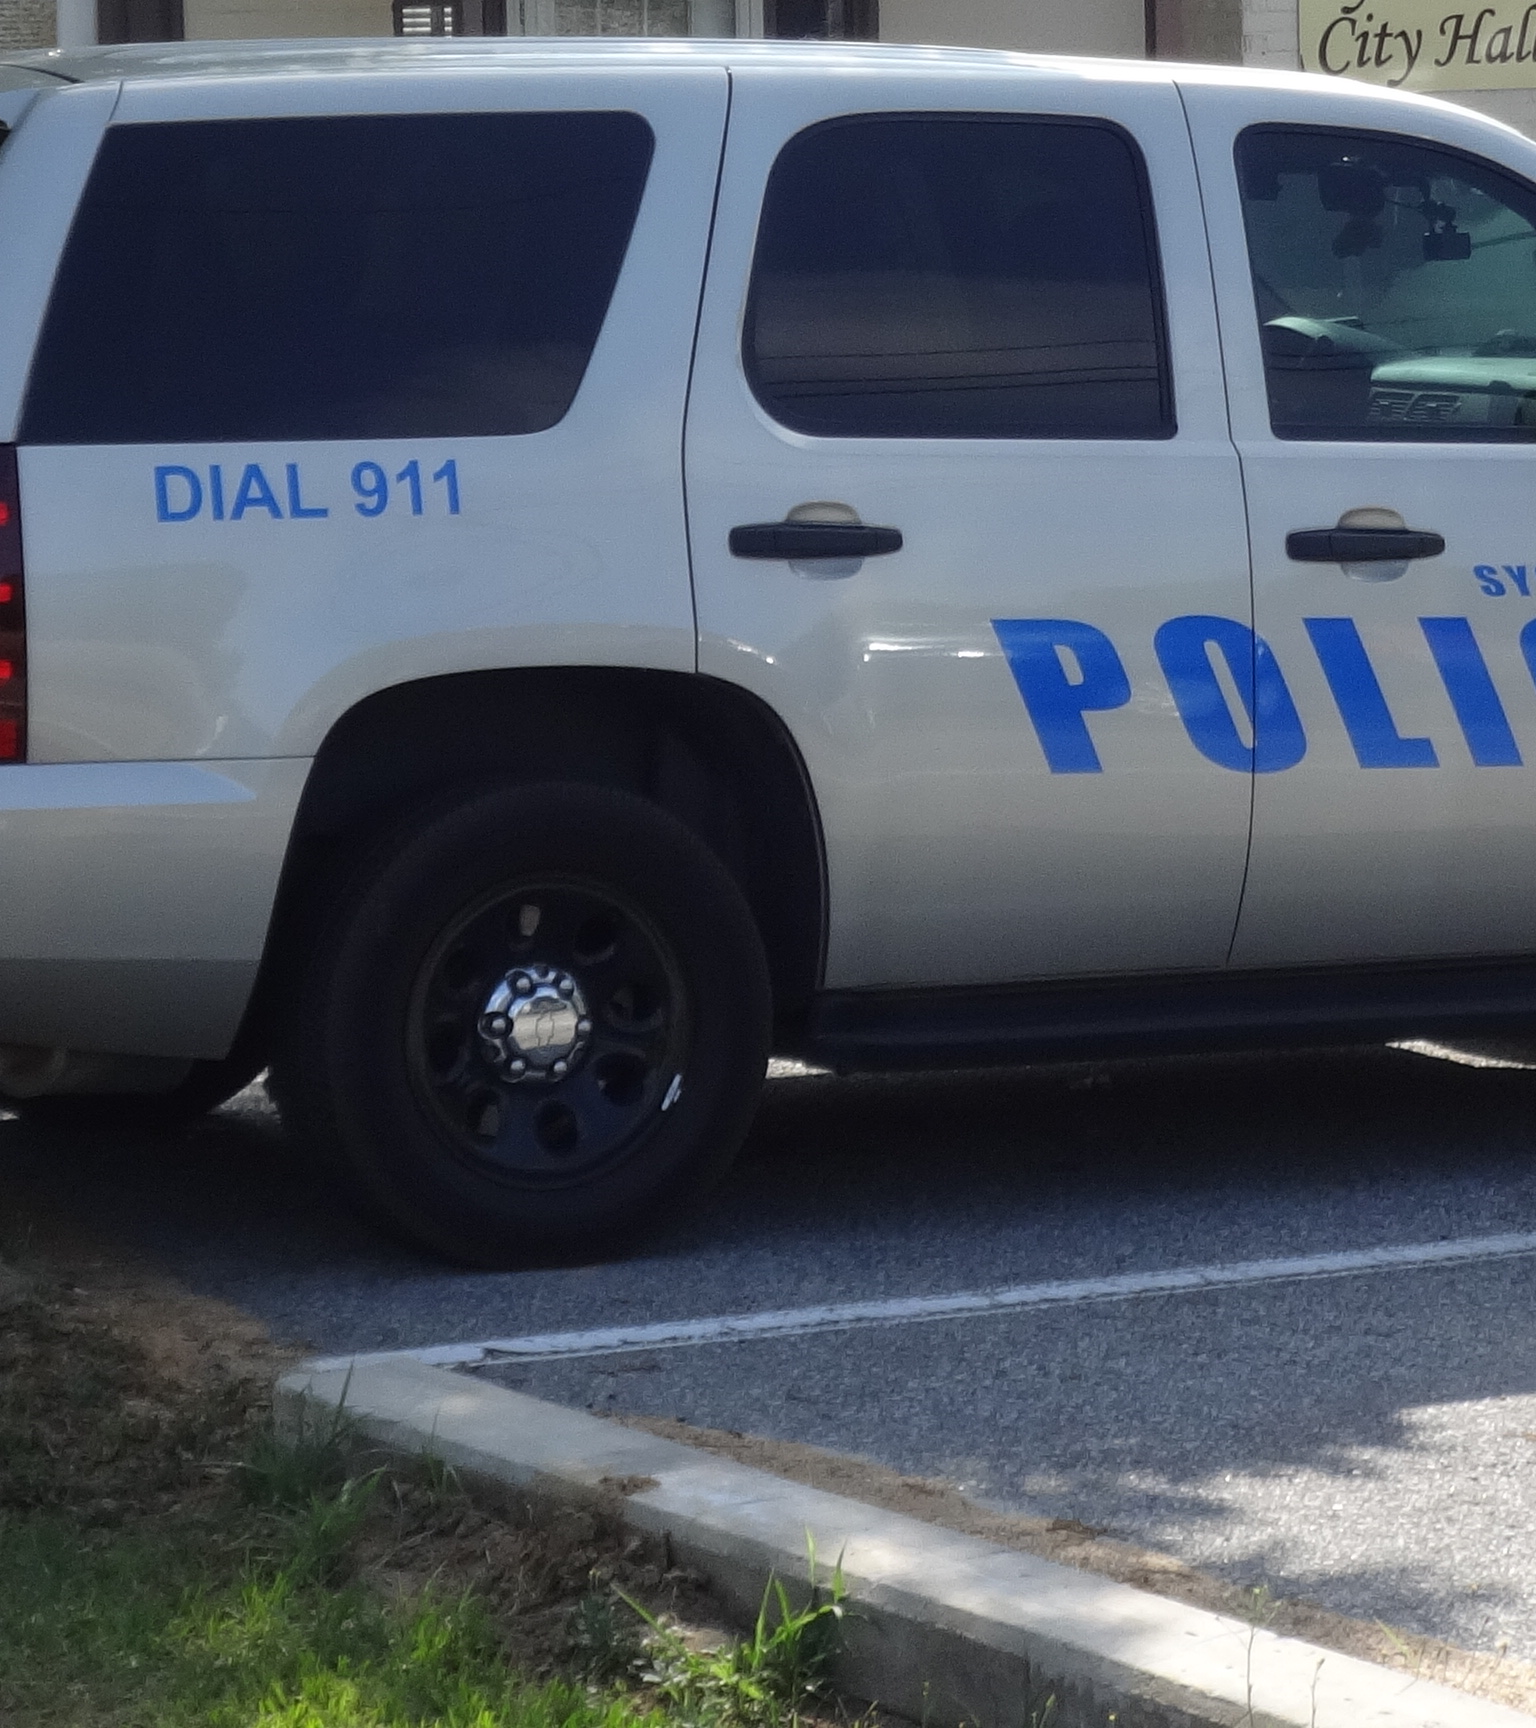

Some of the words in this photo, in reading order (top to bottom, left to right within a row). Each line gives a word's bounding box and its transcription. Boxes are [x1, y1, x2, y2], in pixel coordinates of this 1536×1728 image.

[1318, 12, 1424, 88] City
[152, 462, 330, 524] DIAL
[349, 458, 461, 519] 911
